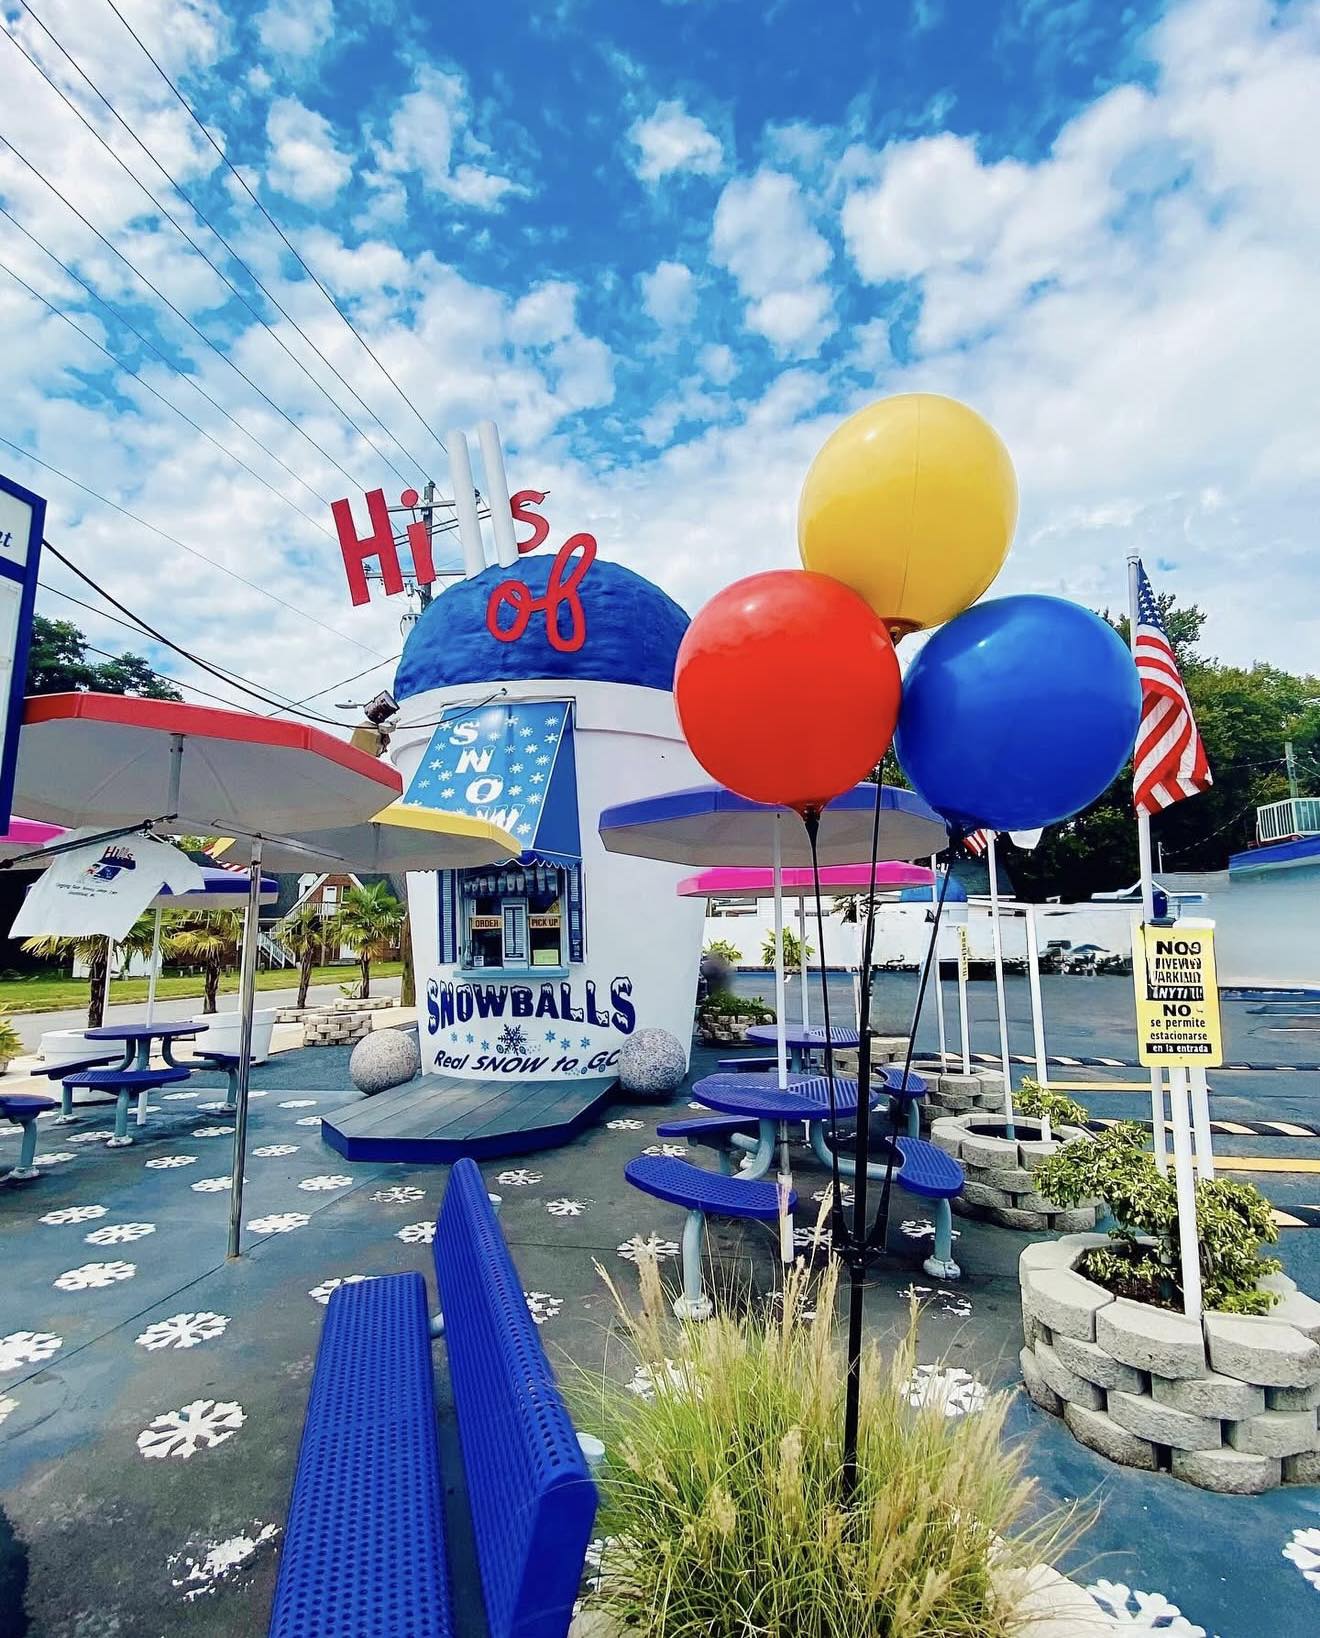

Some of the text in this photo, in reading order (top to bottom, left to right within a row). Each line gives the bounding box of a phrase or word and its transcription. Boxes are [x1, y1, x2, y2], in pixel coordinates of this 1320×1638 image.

[331, 420, 550, 607] Hills
[486, 533, 597, 652] of
[475, 919, 499, 928] ORDER
[532, 919, 558, 927] PICK UP
[427, 976, 636, 1035] SNOWBALLS
[1163, 1004, 1192, 1017] NO
[1150, 1017, 1206, 1030] se permite
[1150, 1031, 1208, 1041] estacionarse
[1152, 1044, 1209, 1053] en la entrada
[434, 1049, 470, 1070] Real
[471, 1055, 550, 1074] SNOW
[551, 1055, 580, 1072] to
